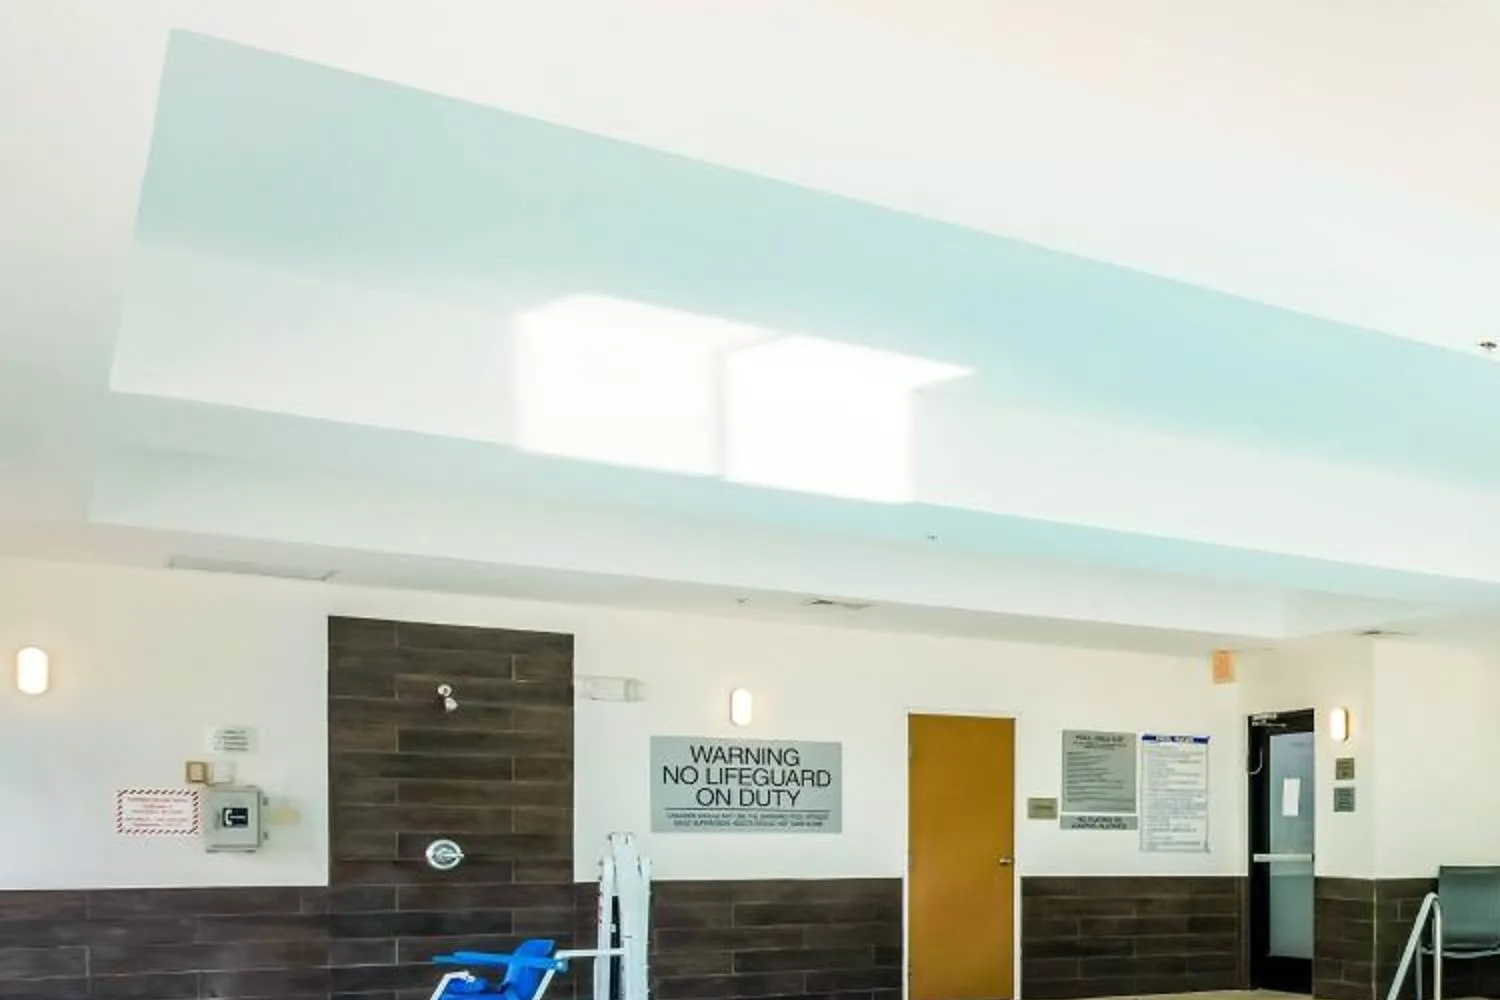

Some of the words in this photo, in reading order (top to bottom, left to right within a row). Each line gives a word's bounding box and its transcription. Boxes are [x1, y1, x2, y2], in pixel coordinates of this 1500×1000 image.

[690, 745, 801, 767] WARNING
[663, 766, 699, 785] NO
[706, 768, 832, 788] LIFEGUARD
[696, 787, 731, 808] ON
[740, 789, 801, 807] DUTY
